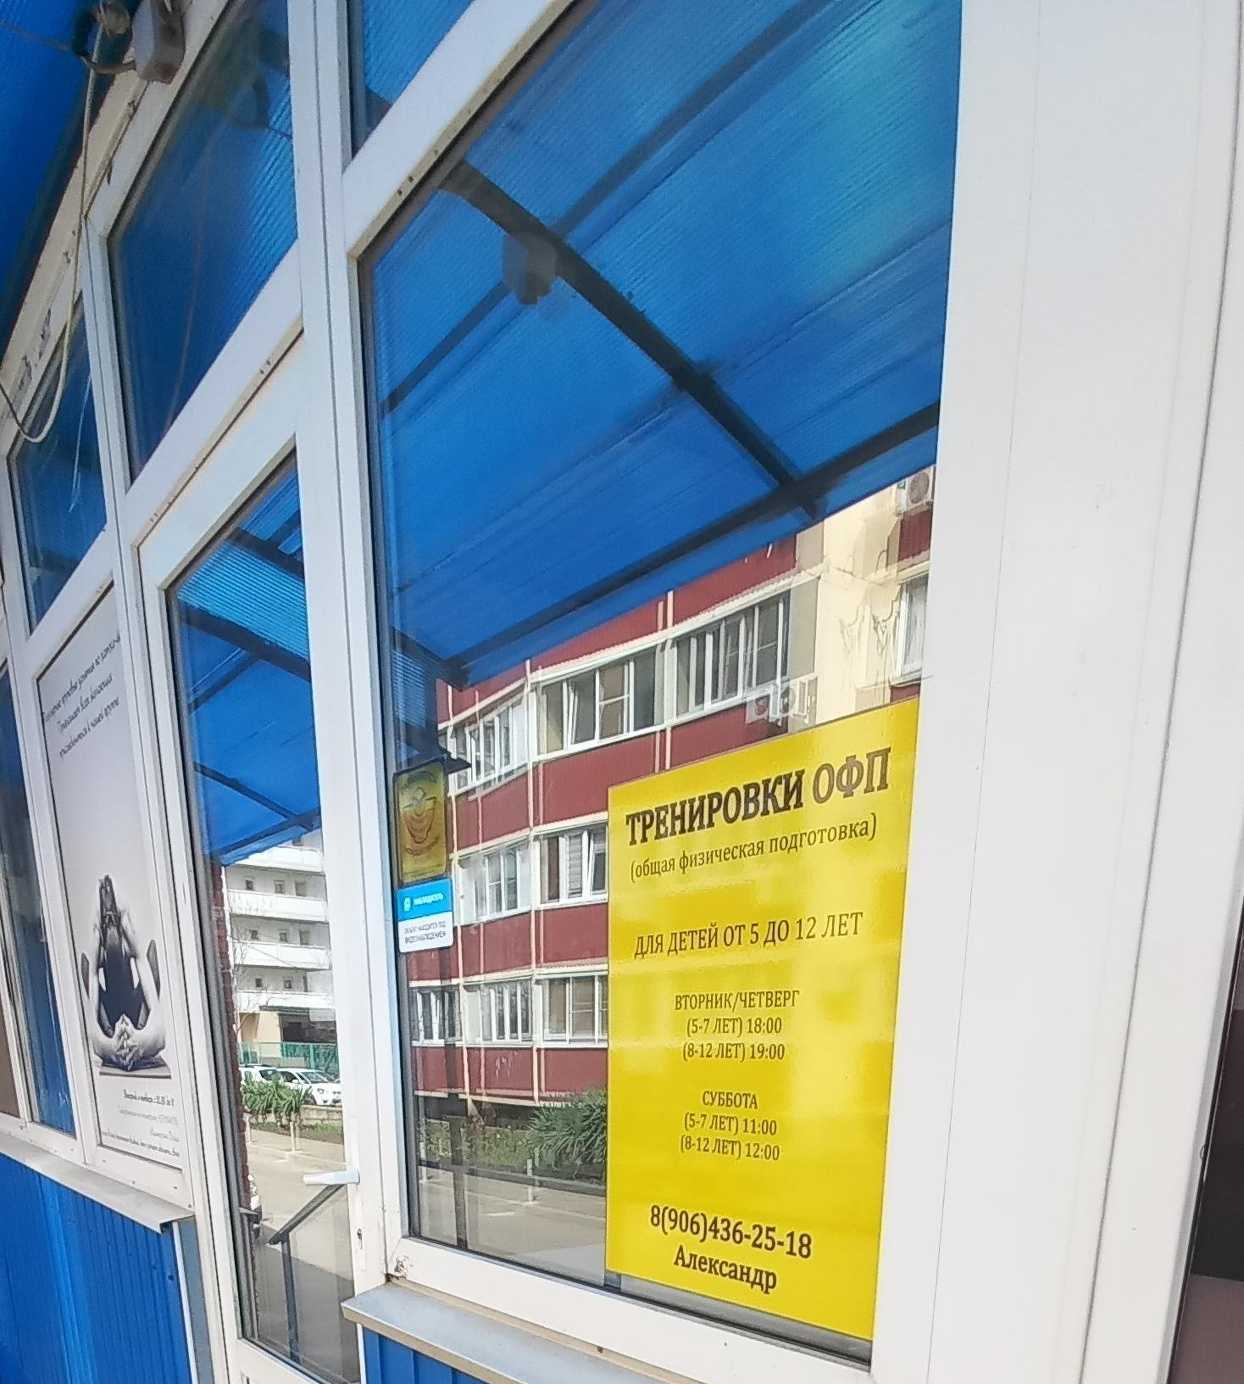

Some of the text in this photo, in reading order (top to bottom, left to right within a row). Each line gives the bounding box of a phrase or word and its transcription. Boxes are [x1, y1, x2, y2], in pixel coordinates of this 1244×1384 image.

[625, 747, 892, 846] ТРЕНИРОВКИ ОФП
[630, 812, 878, 882] (общая физическая подготовка)
[634, 911, 864, 960] ДЛЯ ДЕТЕЙ ОТ 5 ДО 12 ЛЕТ
[674, 989, 800, 1012] ВТОРНИК/ЧЕТВЕРГ
[686, 1017, 782, 1037] (5-7 ЛЕТ) 18:00
[682, 1043, 785, 1062] (8-12 ЛЕТ) 19:00
[702, 1090, 758, 1110] СУББОТА
[684, 1111, 777, 1136] (5-7 ЛЕТ) 11:00
[680, 1134, 780, 1161] (8-12 ЛЕТ) 12:00
[650, 1204, 812, 1260] 8(906)436-25-18
[673, 1244, 778, 1294] Александр
